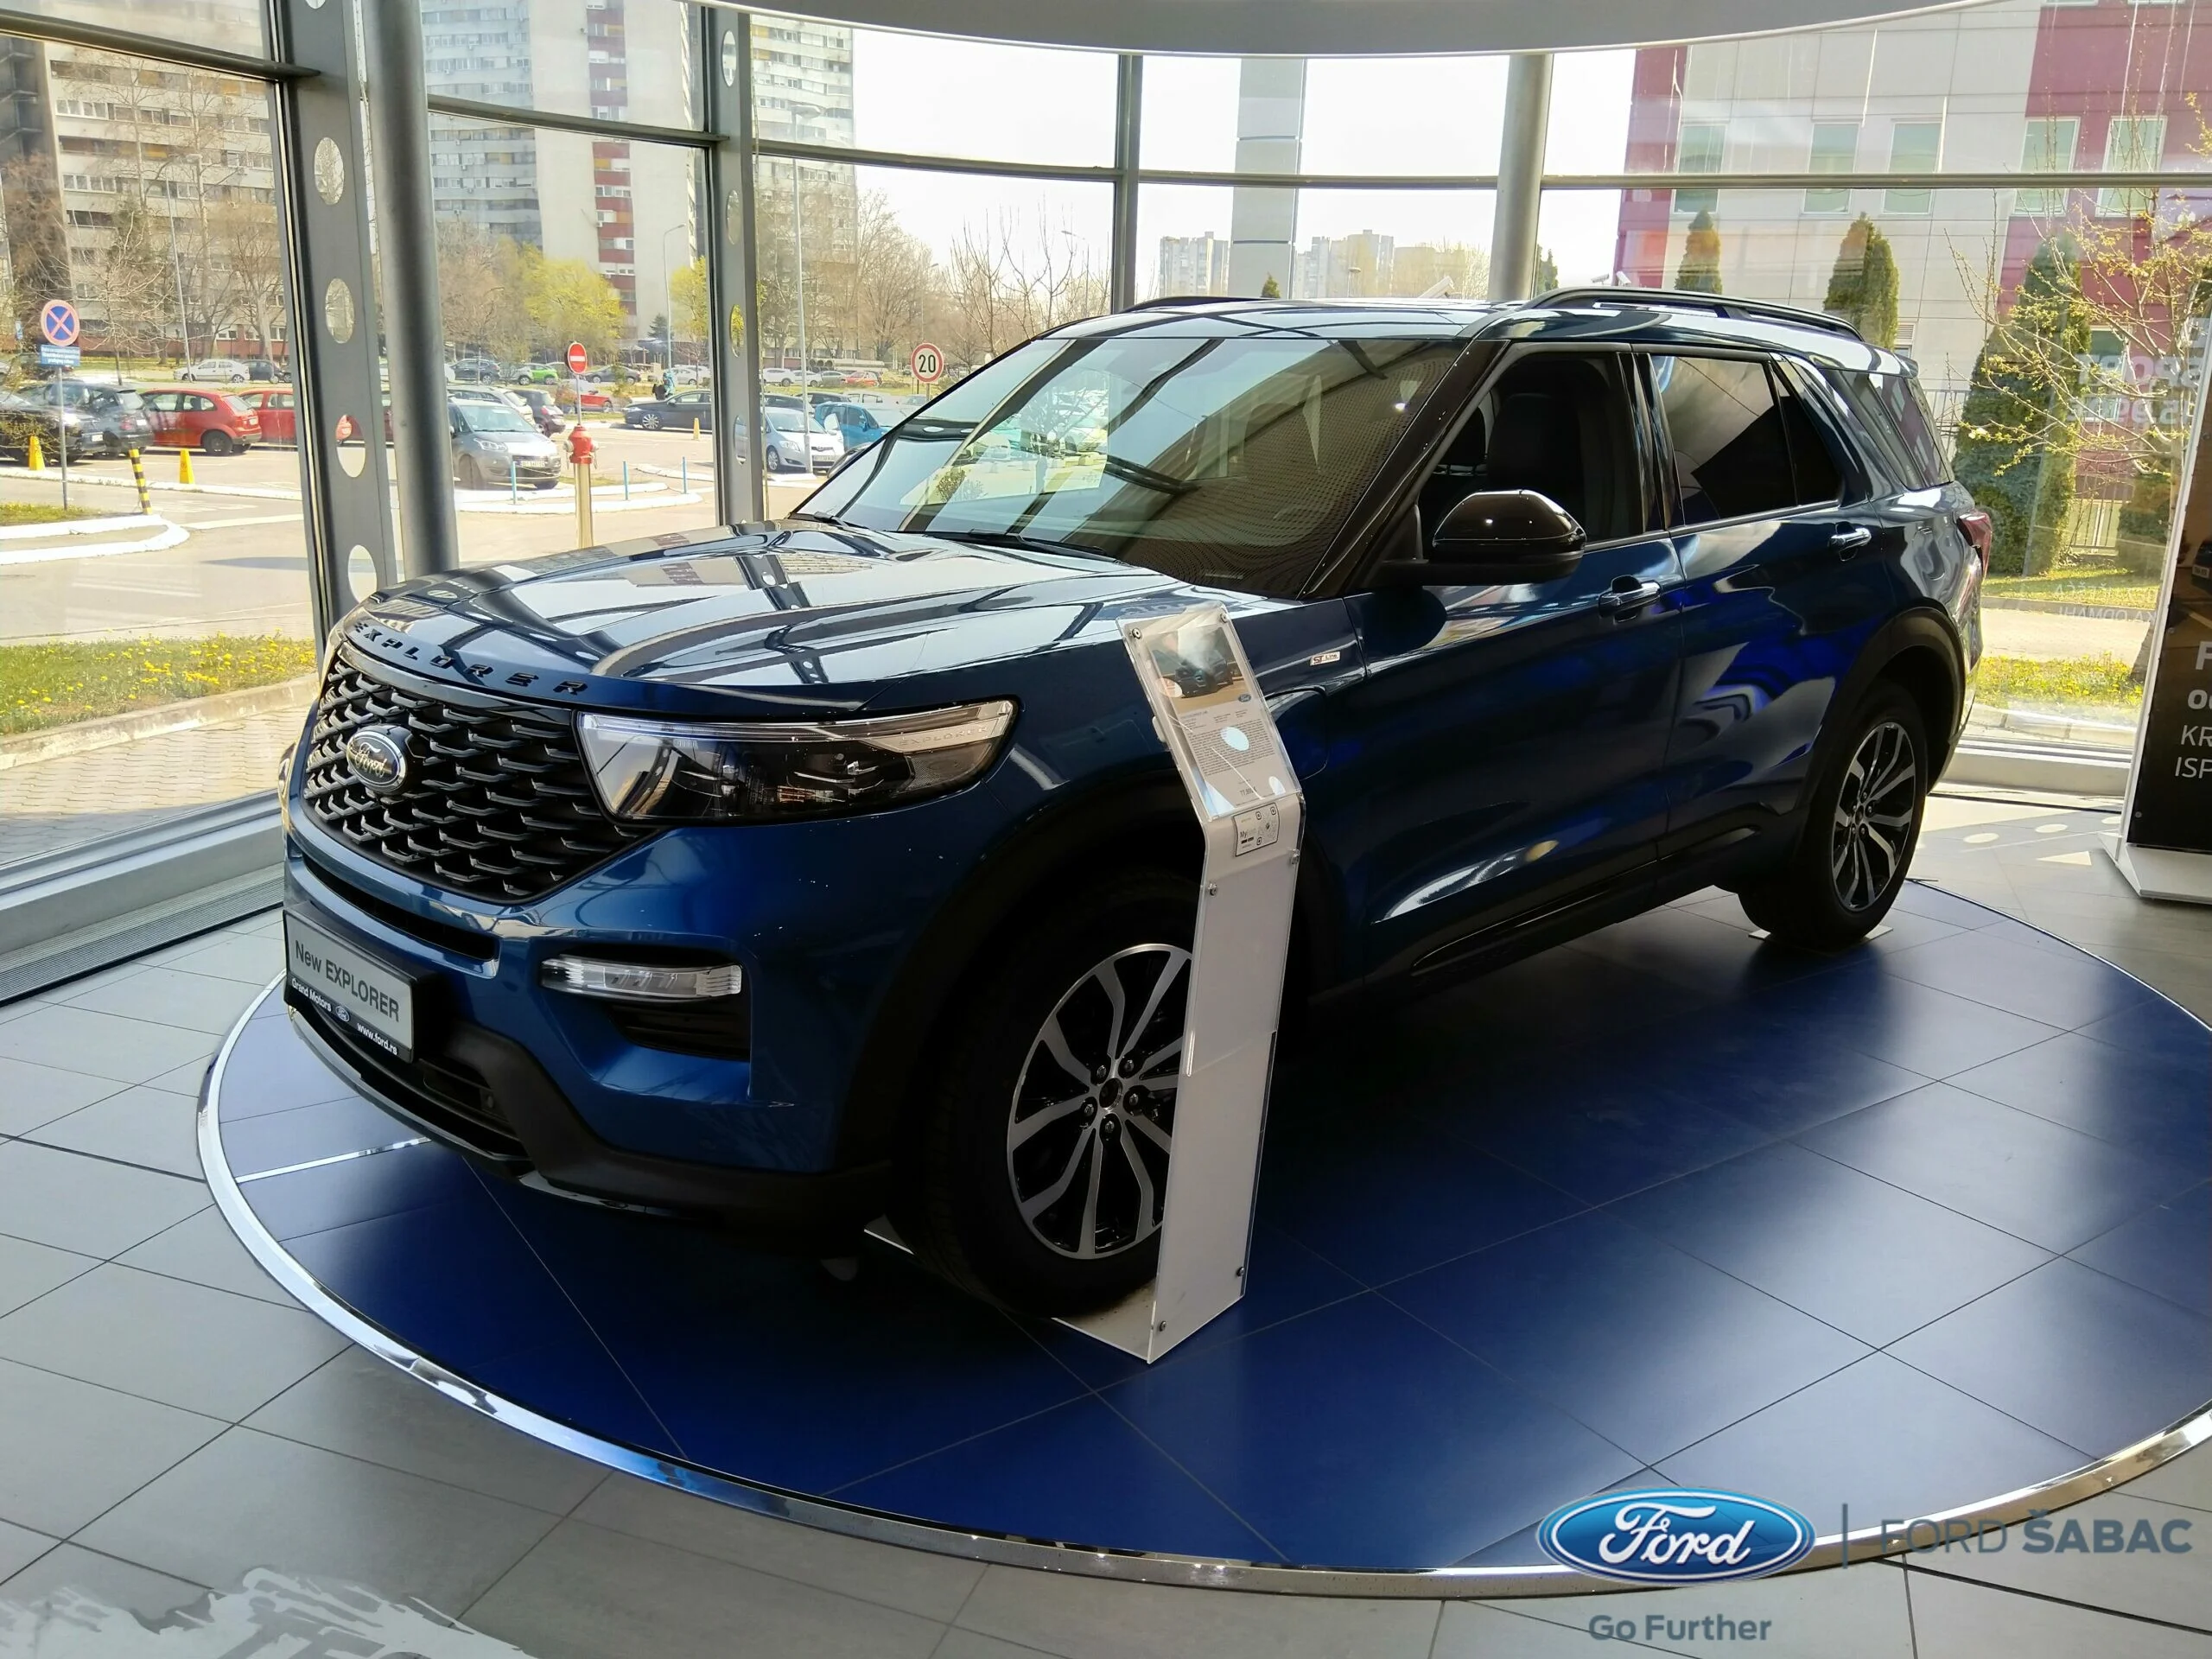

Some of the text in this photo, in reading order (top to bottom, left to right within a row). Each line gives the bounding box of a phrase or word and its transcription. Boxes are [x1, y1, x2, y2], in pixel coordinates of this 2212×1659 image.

[918, 354, 936, 372] 20
[296, 939, 399, 1022] New EXPLORER
[309, 988, 332, 1012] Motors
[357, 1022, 397, 1056] www.ford.rs
